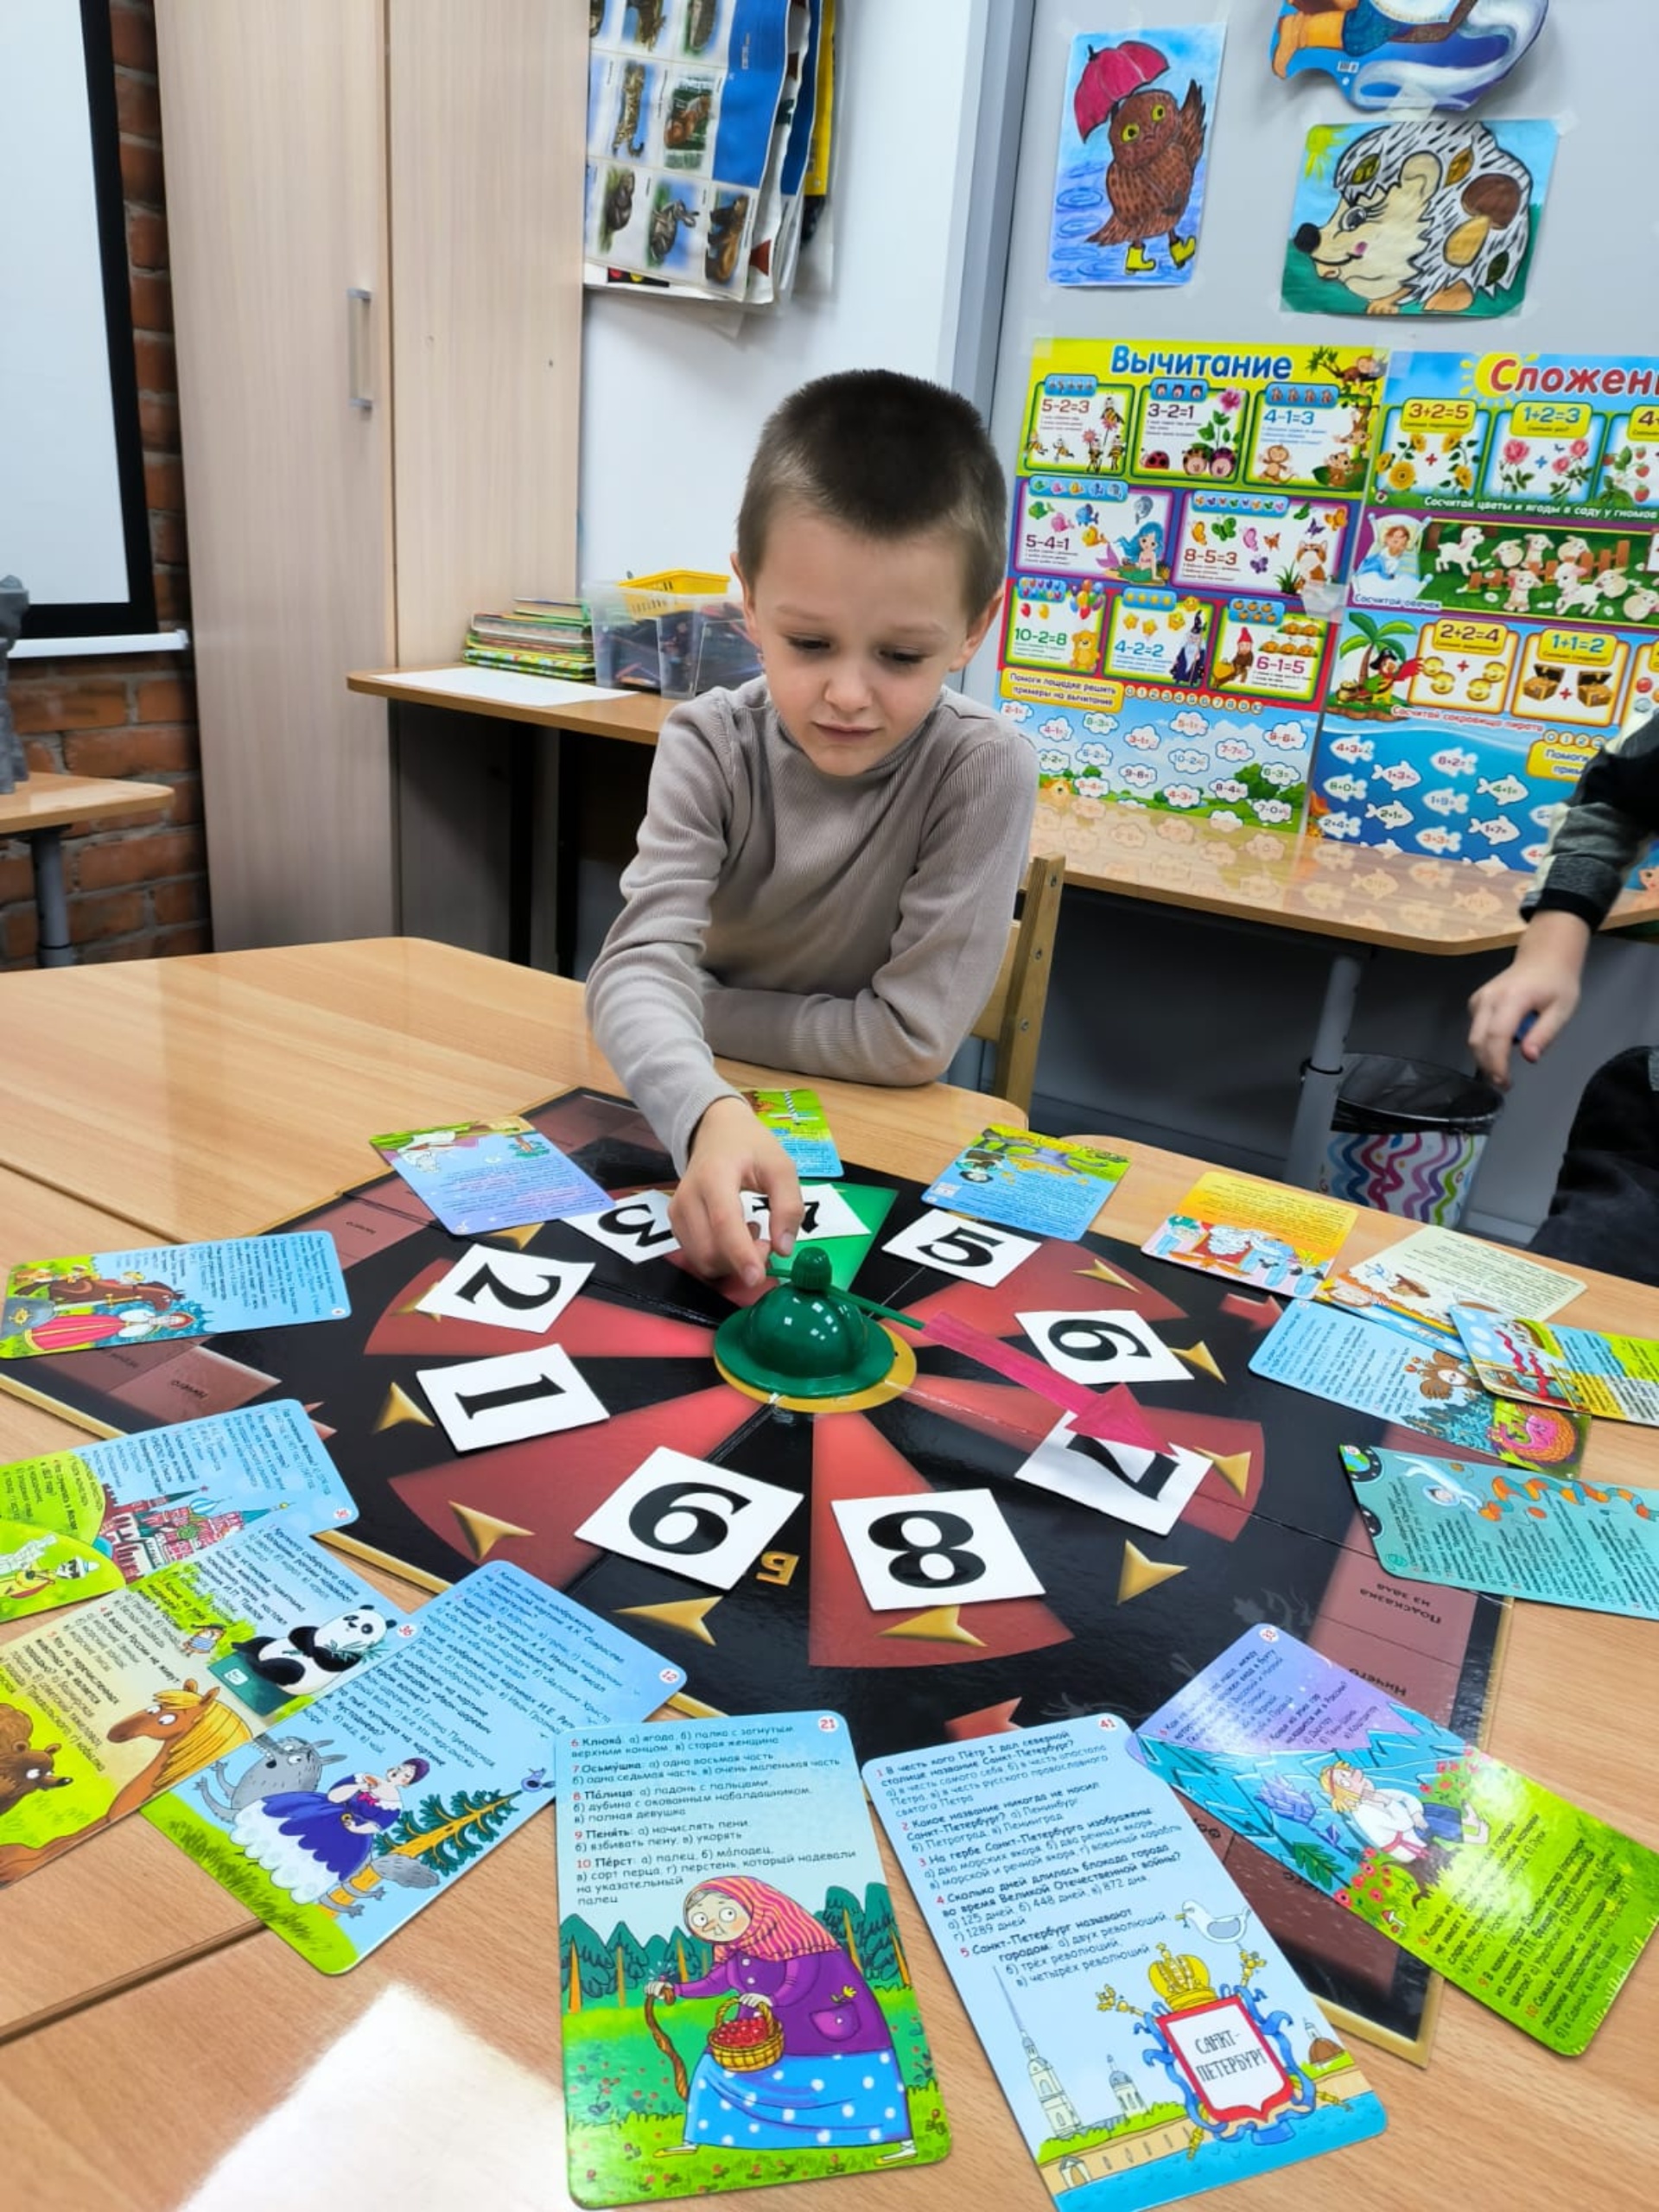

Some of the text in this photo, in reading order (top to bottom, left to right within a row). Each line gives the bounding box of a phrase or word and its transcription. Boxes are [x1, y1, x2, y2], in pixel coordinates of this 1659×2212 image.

[1111, 345, 1293, 380] Вычитание
[1042, 399, 1090, 414] 5-2=3
[1147, 403, 1194, 419] 3-2=1
[1264, 409, 1315, 425] 4-1=3
[1408, 404, 1470, 420] 3+2=5
[1524, 407, 1580, 423] 1+2=3
[1425, 497, 1473, 508] Сосчитай
[1477, 500, 1511, 512] цветы
[1525, 503, 1560, 516] ягоды
[1573, 506, 1600, 518] саду
[1614, 509, 1657, 518] гномов
[1025, 535, 1070, 551] 5-4=1
[1184, 550, 1237, 565] 8-5=3
[1354, 593, 1402, 607] Сосчитай
[1014, 628, 1067, 646] 10-2=8
[1440, 624, 1500, 643] 2+2=4
[1552, 634, 1606, 654] 1+1=2
[1115, 639, 1164, 658] 4-2=2
[1256, 656, 1306, 675] 6-1=5
[1010, 673, 1116, 695] Помоги лошадке решить
[1014, 686, 1051, 701] примеры
[1068, 693, 1113, 707] вычитание
[1392, 706, 1440, 721] Сосчитай
[1507, 721, 1544, 733] пирата
[598, 1203, 675, 1250] 3
[918, 1226, 1004, 1268] 5
[456, 1263, 561, 1311] 2
[455, 1374, 566, 1420] 1
[1066, 1436, 1180, 1501] 7
[868, 1510, 986, 1588] 8
[1376, 1583, 1431, 1607] из зала
[1360, 1588, 1441, 1624] Подсказка
[1349, 1668, 1407, 1697] Ничего
[741, 1726, 793, 1736] загнутым
[818, 1717, 837, 1731] 21
[1099, 1717, 1118, 1730] 41
[570, 1737, 779, 1758] верхним старая женщина
[897, 1761, 928, 1771] честь
[930, 1755, 956, 1765] кого
[998, 1741, 1020, 1752] дал
[1021, 1731, 1070, 1746] северной
[662, 1758, 690, 1767] одна
[693, 1755, 740, 1764] восьмая
[881, 1739, 1073, 1786] столице название Санкт-Петербург?
[585, 1760, 808, 1784] одна седьмая маленькая
[588, 1800, 632, 1812] дубина
[644, 1795, 711, 1807] окованным
[911, 1815, 945, 1828] Какое
[949, 1803, 1000, 1820] название
[1002, 1793, 1047, 1808] никогда
[1065, 1781, 1099, 1794] носил
[588, 1808, 685, 1822] полная девушка
[652, 1822, 714, 1834] начислять
[906, 1811, 1005, 1841] Санкт-Петербург?
[589, 1831, 742, 1851] взбивать укорять
[949, 1846, 981, 1859] гербе
[984, 1823, 1084, 1851] Санкт-Петербурга
[590, 1851, 856, 1881] сорт который надевали
[946, 1885, 995, 1903] Сколько
[998, 1876, 1027, 1892] дней
[1031, 1866, 1079, 1884] длилась
[1081, 1853, 1128, 1871] блокада
[1131, 1844, 1169, 1858] города
[594, 1876, 683, 1893] указательный
[960, 1897, 996, 1914] время
[998, 1883, 1051, 1904] Великой
[1052, 1863, 1137, 1890] Отечественной
[1141, 1851, 1180, 1869] войны?
[576, 1895, 618, 1905] палец
[960, 1894, 1056, 1926] 125 448
[965, 1922, 994, 1938] 1289
[971, 1923, 1070, 1955] Санкт-Петербург
[1075, 1908, 1131, 1928] называют
[1195, 2030, 1241, 2055] САНКТ-
[1195, 2048, 1268, 2082] ПЕТЕРБУРГ
